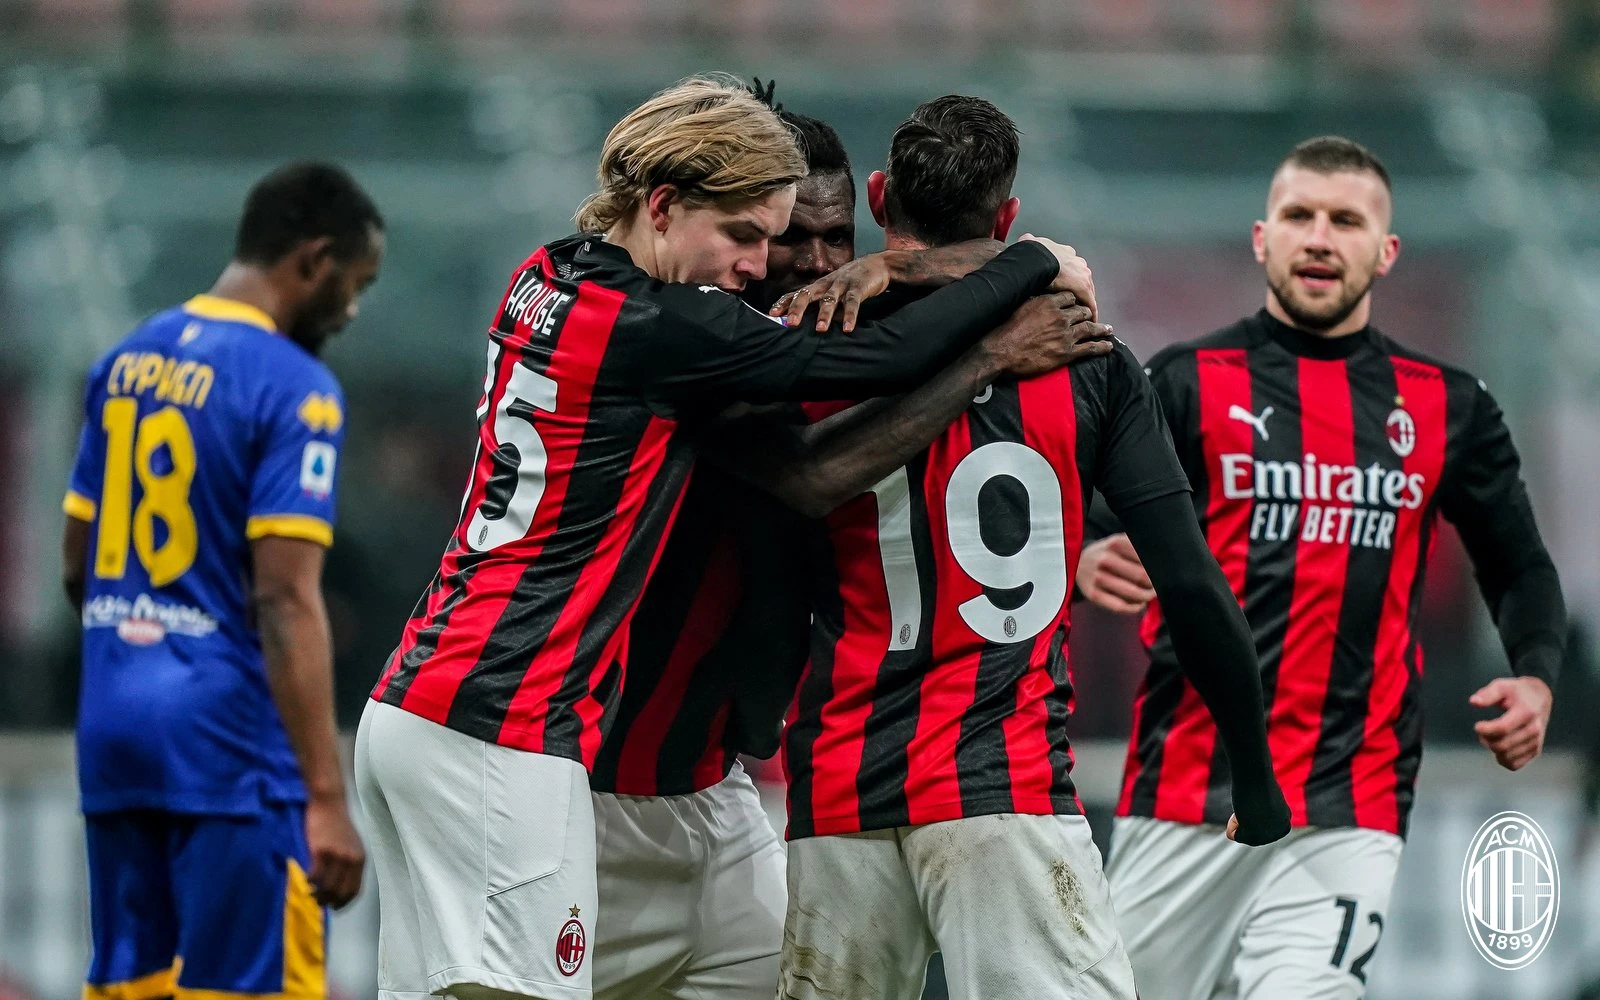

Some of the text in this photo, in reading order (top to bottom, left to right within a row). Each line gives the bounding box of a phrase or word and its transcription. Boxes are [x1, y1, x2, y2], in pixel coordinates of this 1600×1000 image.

[505, 270, 570, 336] HAUGE
[95, 397, 198, 588] 18
[1220, 453, 1425, 509] Emirates
[863, 441, 1067, 651] 19
[1250, 503, 1396, 549] FLY BETTER
[1328, 898, 1384, 985] 12
